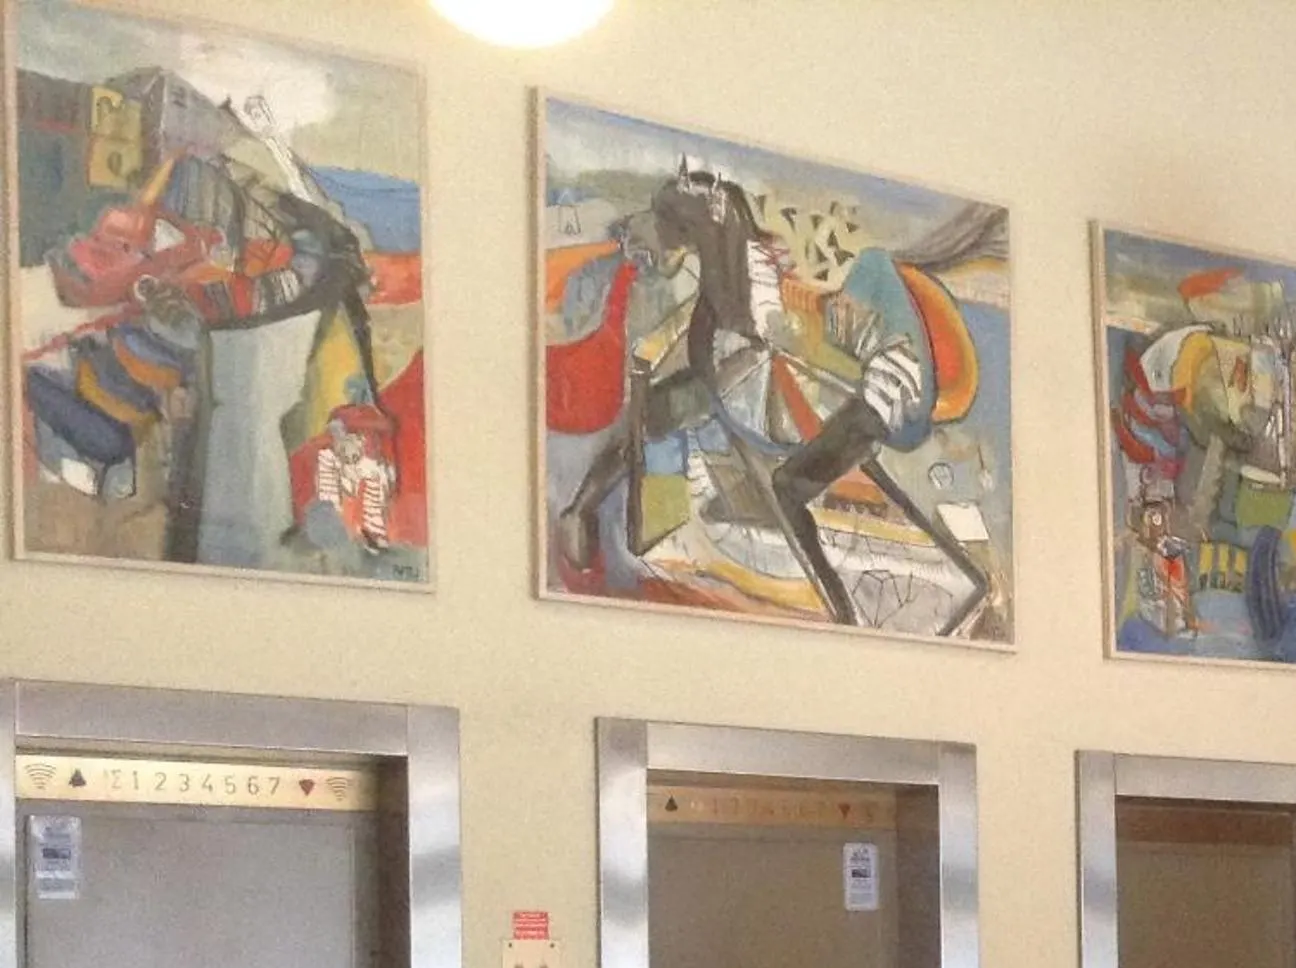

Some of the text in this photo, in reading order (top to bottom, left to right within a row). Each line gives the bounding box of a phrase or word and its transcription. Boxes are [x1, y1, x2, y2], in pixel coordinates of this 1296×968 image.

[154, 772, 167, 791] 2
[177, 773, 190, 792] 3
[201, 773, 213, 792] 4
[224, 774, 236, 794] 5
[248, 776, 259, 795] 6
[268, 776, 281, 795] 7
